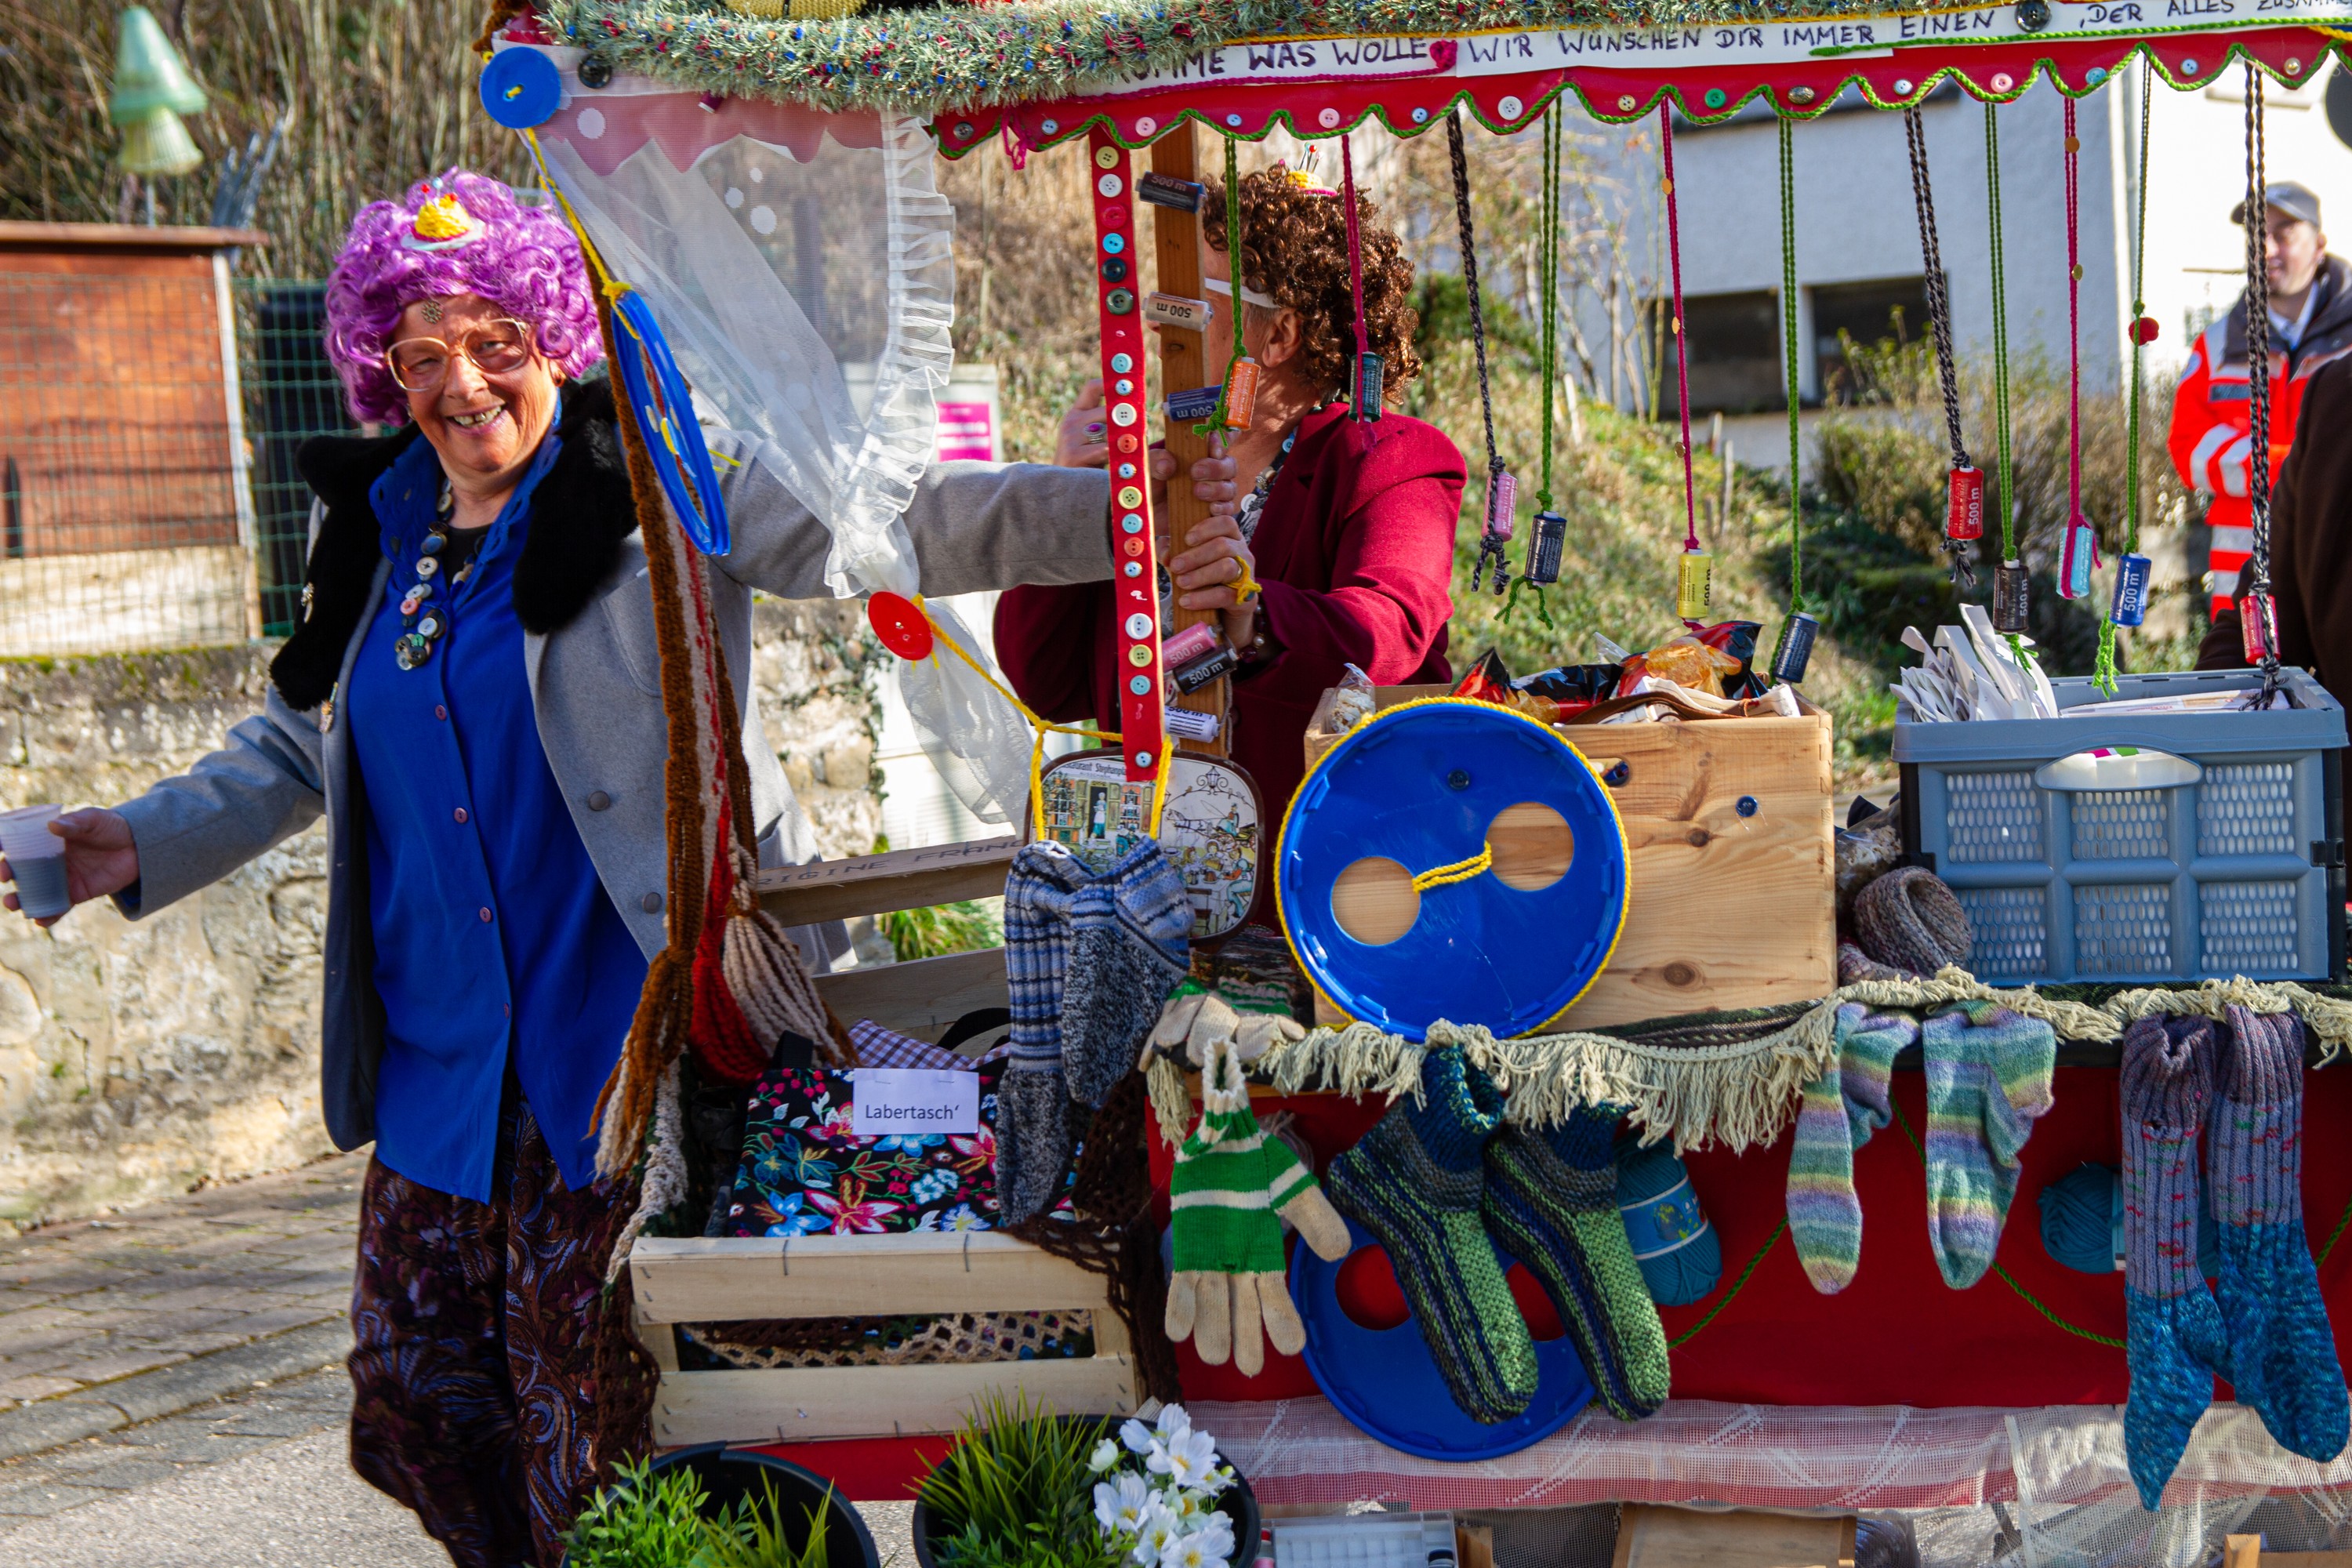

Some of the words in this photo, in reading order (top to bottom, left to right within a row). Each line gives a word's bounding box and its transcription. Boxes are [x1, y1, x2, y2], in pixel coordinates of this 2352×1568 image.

[1468, 34, 1533, 63] WIR
[1715, 27, 1763, 49] DIR
[1784, 24, 1875, 47] IMMER
[1900, 9, 1995, 39] EINEN
[2167, 0, 2234, 16] ALLES
[1247, 43, 1316, 71] WAS
[1331, 38, 1428, 65] WOLLE
[1151, 175, 1174, 187] 500
[1174, 182, 1187, 191] m
[1156, 303, 1167, 311] m
[1170, 305, 1192, 318] 500
[1176, 409, 1189, 418] m
[1190, 405, 1213, 417] 500
[1971, 488, 1980, 499] m
[1968, 502, 1979, 524] 500
[2022, 579, 2028, 591] m
[2129, 573, 2140, 586] m
[2124, 588, 2137, 612] 500
[1170, 648, 1191, 663] 500
[1192, 642, 1203, 653] m
[1189, 667, 1211, 684] 500
[1210, 662, 1224, 673] m
[757, 860, 889, 885] RIGINE
[914, 839, 1023, 862] FRANC
